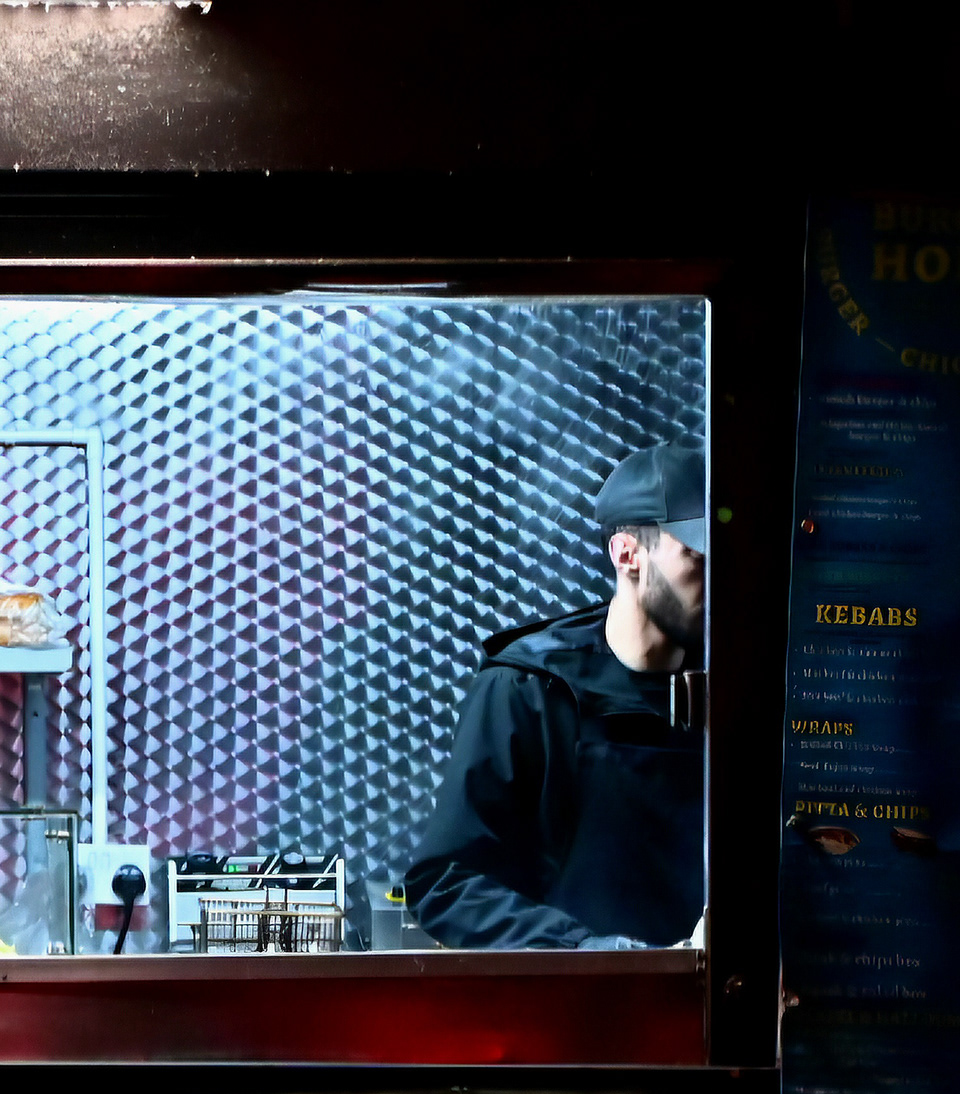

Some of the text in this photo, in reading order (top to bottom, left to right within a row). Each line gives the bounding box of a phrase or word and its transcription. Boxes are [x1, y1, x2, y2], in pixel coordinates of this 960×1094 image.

[871, 243, 960, 283] HO
[815, 604, 918, 626] KEBABS
[791, 720, 853, 736] WRAPS
